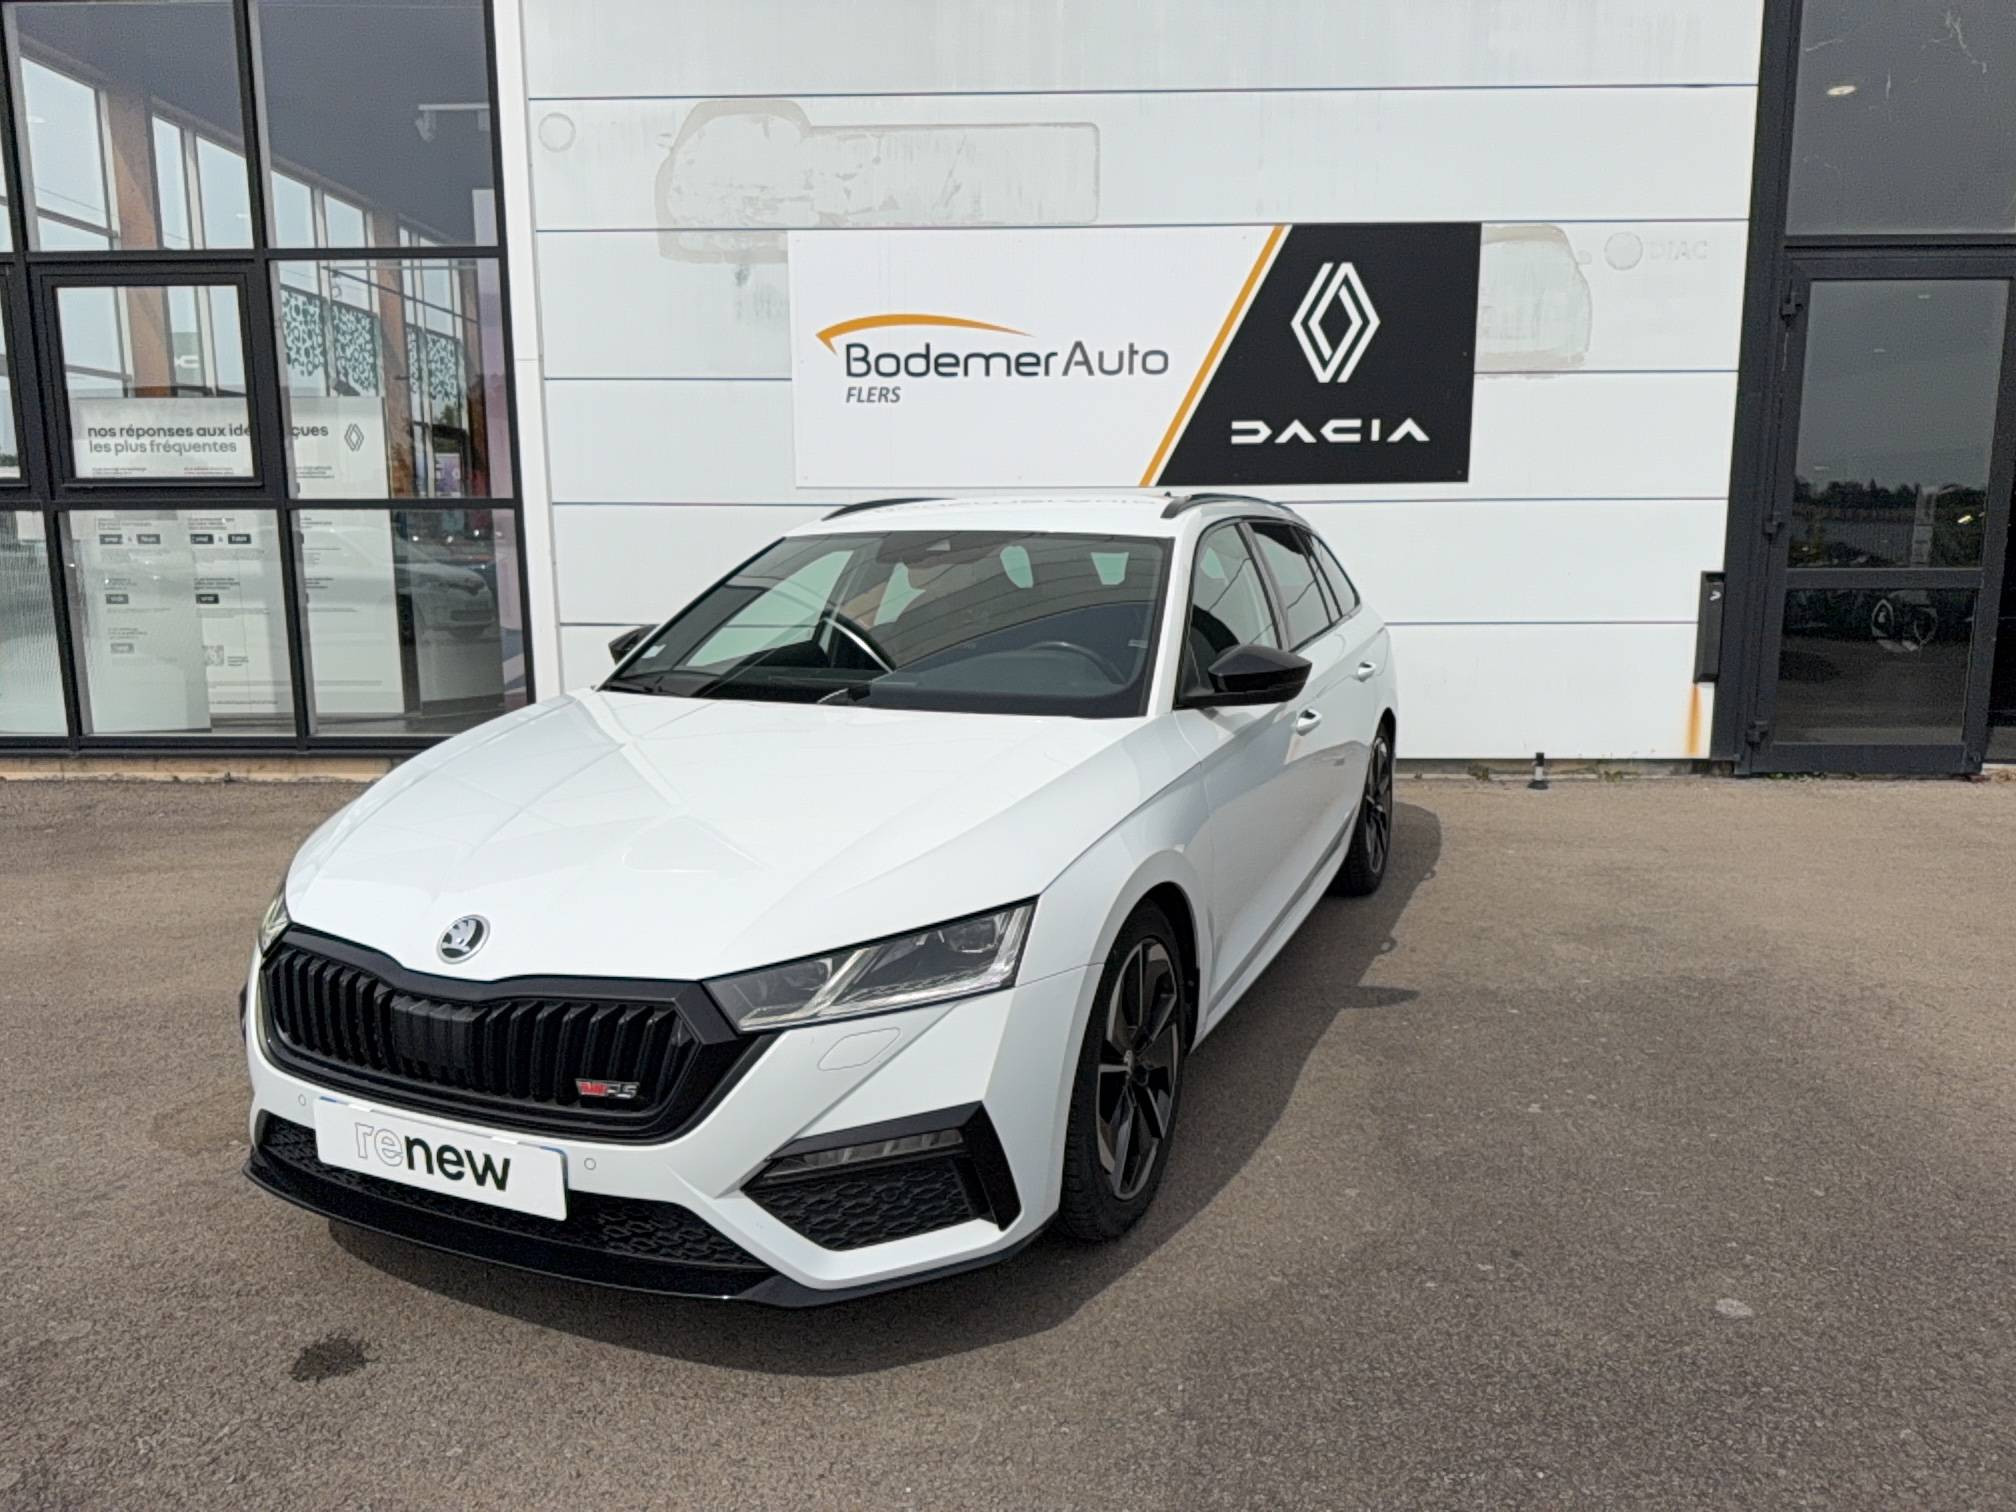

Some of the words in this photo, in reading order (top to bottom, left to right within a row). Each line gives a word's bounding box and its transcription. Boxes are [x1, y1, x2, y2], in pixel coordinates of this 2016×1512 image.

[846, 386, 901, 404] FLERS
[87, 426, 117, 438] nos
[119, 424, 194, 441] réponses
[196, 426, 226, 438] aux
[291, 426, 329, 440] çues
[1230, 417, 1430, 444] DACIA
[89, 439, 111, 453] les
[114, 440, 147, 456] plus
[150, 440, 237, 456] fréquentes
[354, 1121, 511, 1192] renew
